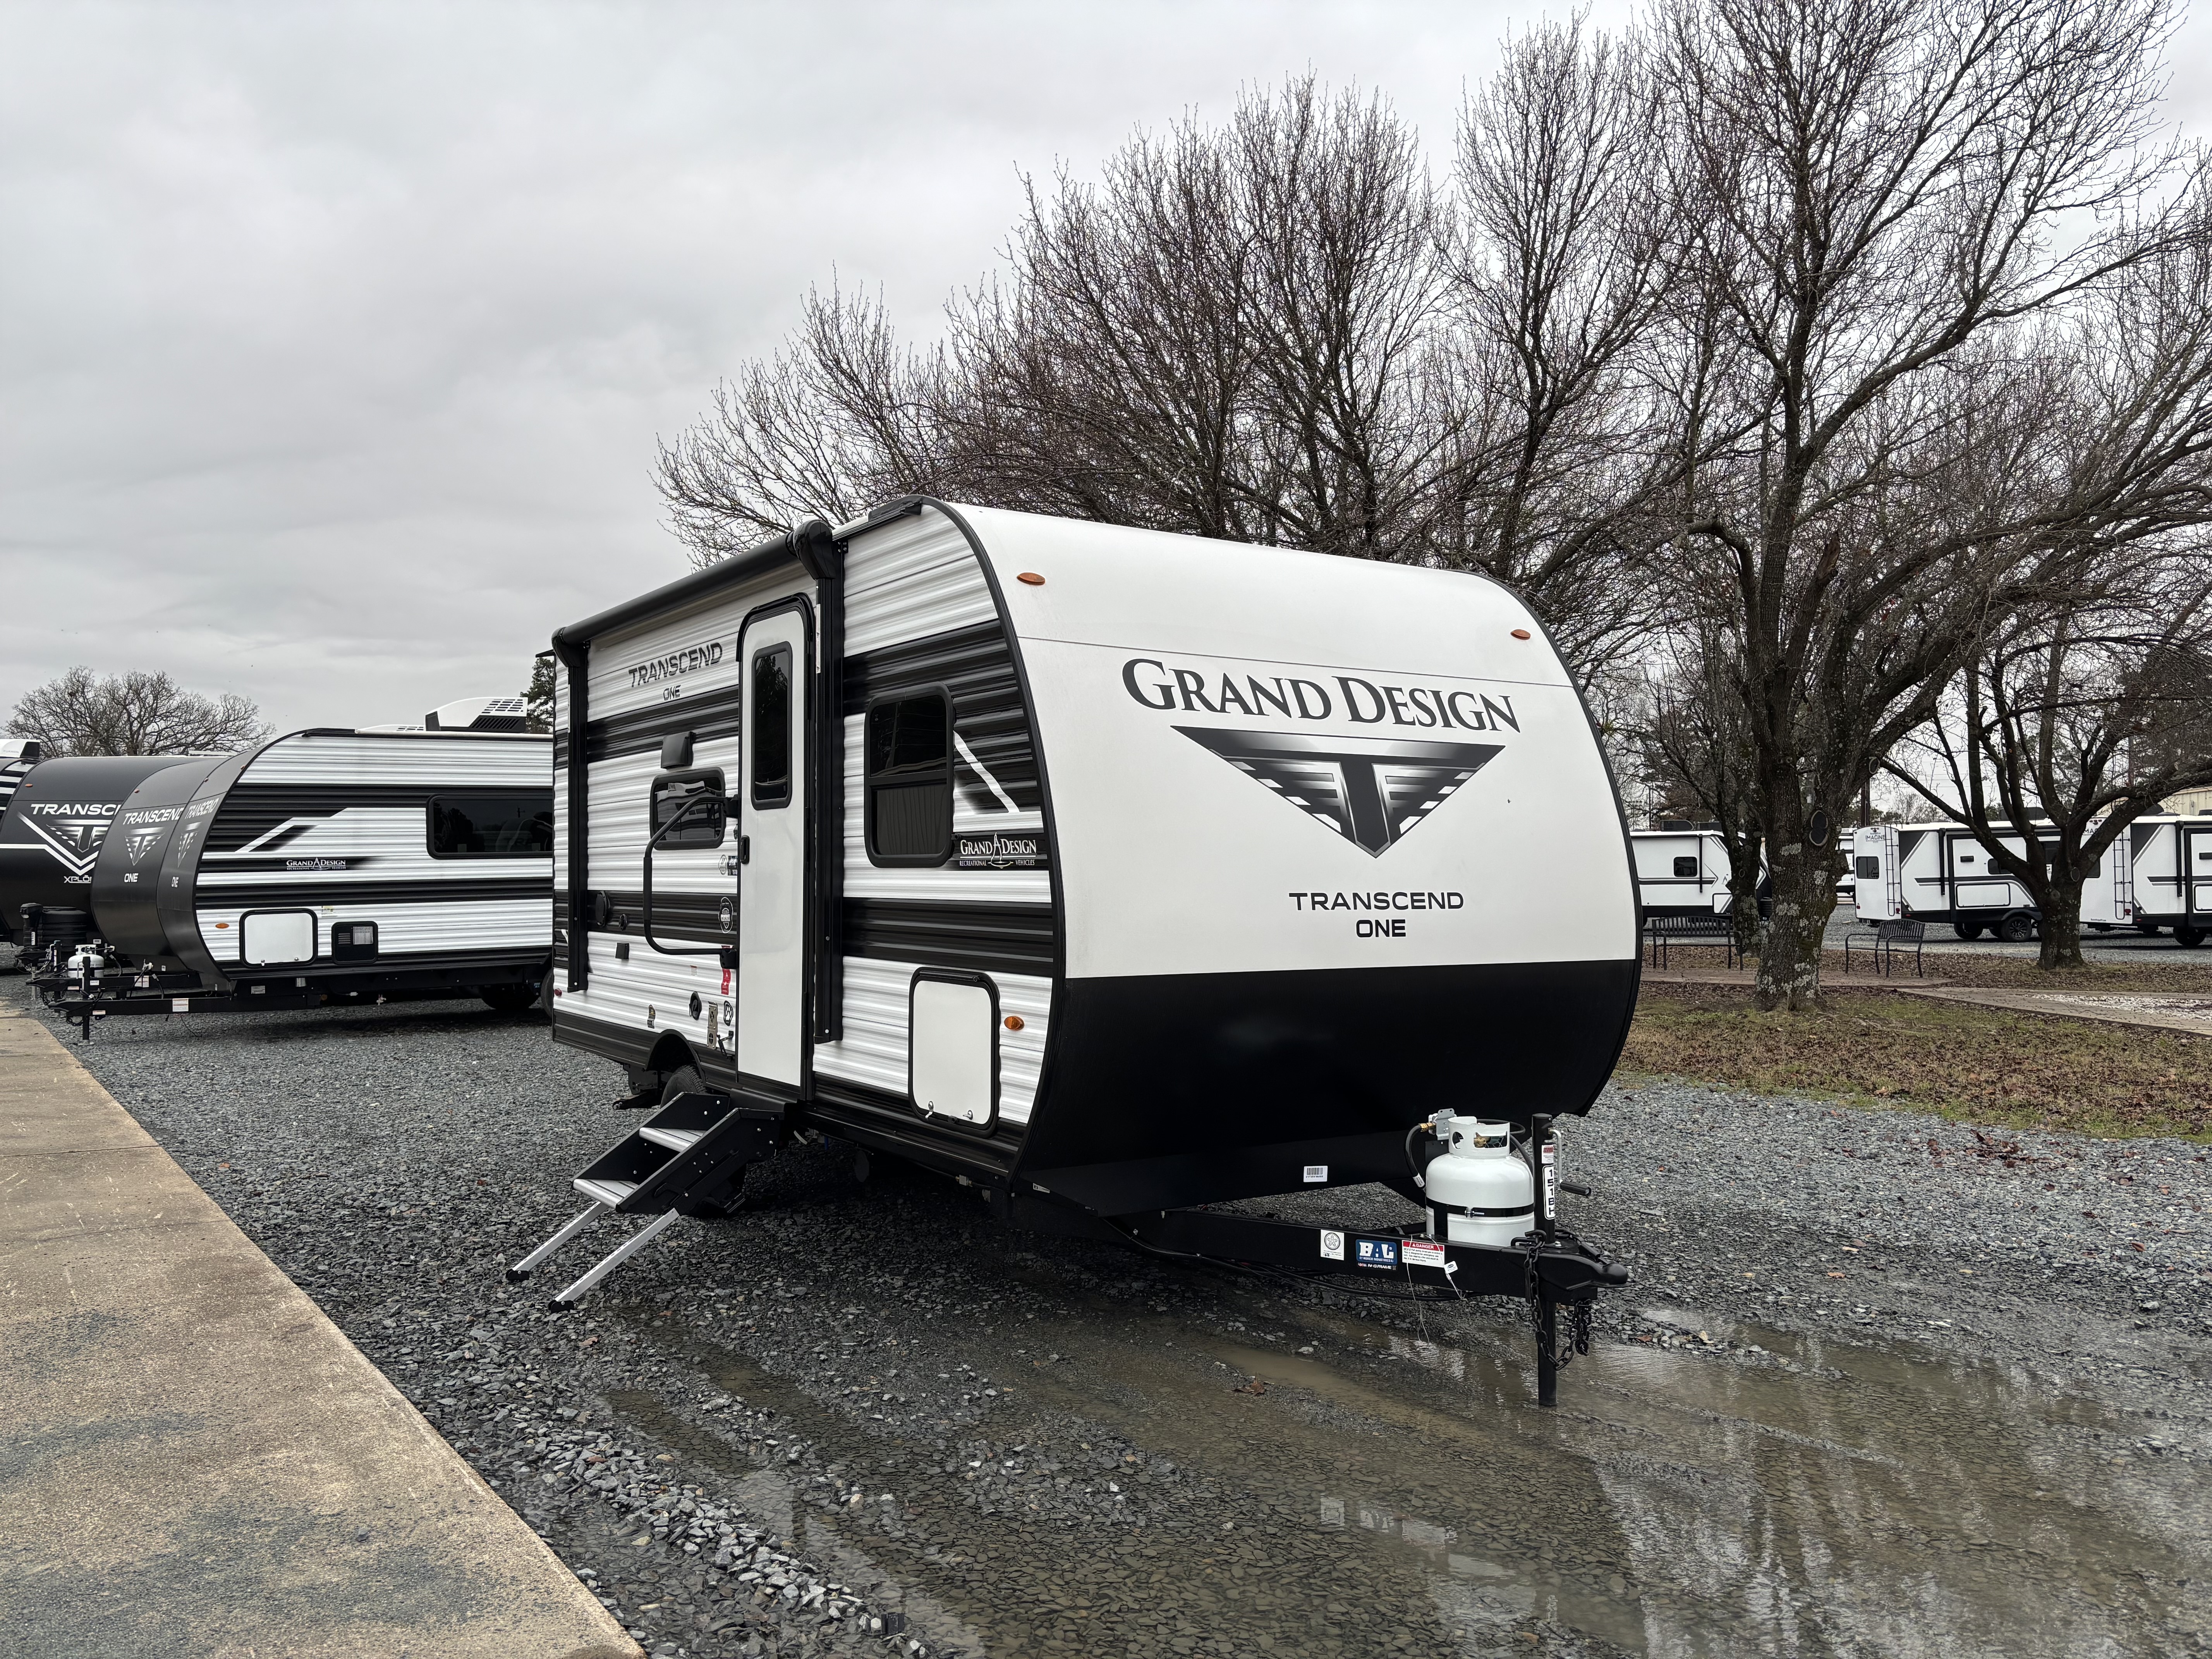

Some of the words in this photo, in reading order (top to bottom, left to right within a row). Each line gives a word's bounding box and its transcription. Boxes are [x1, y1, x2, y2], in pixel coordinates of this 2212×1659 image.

[629, 642, 723, 687] TRANSCEND
[663, 685, 681, 701] ONE
[1122, 659, 1331, 720] GRAND
[1331, 676, 1520, 733] DESIGN
[31, 804, 122, 815] TRANSC
[960, 840, 993, 855] GRAND
[1000, 838, 1036, 854] DESIGN
[124, 873, 139, 883] ONE
[1288, 892, 1464, 911] TRANSCEND
[1356, 919, 1406, 938] ONE
